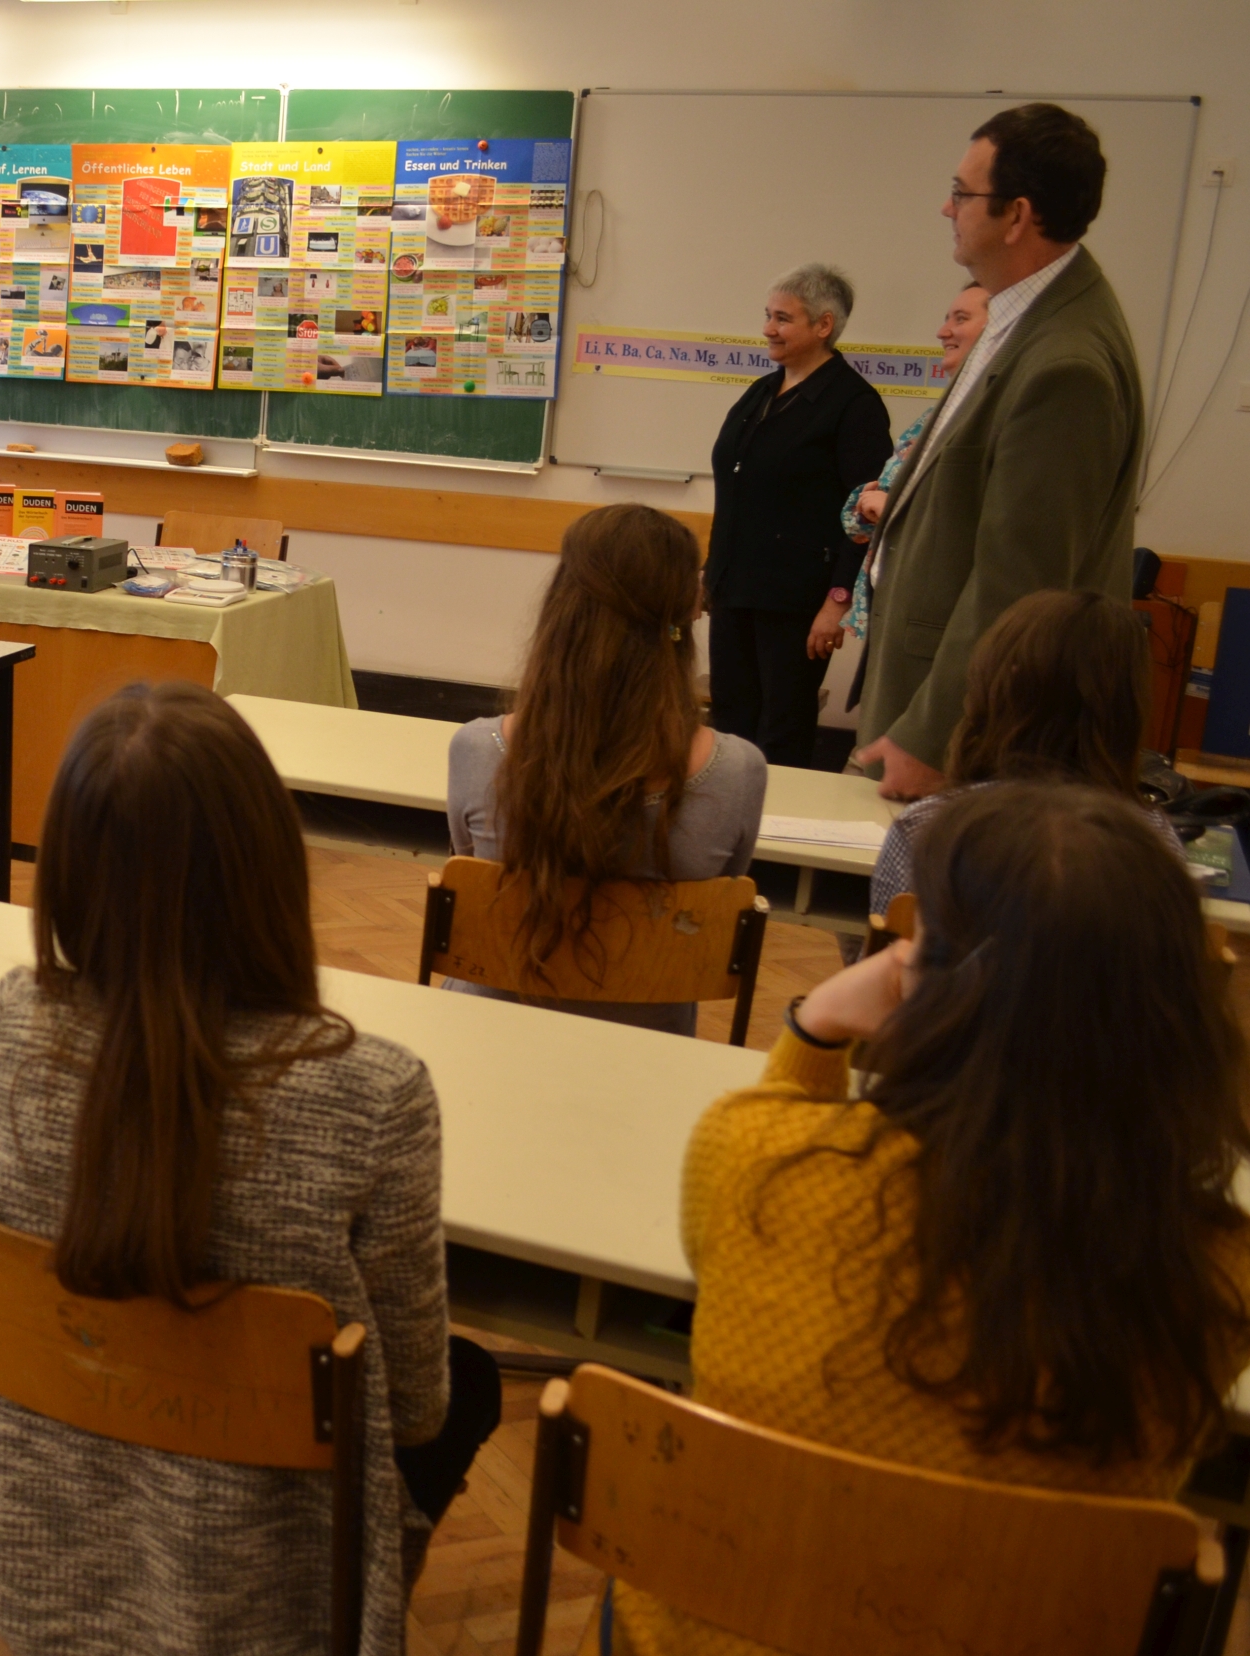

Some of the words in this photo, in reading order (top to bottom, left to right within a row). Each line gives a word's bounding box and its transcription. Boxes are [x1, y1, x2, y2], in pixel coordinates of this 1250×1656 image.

[12, 164, 48, 175] Lernen
[81, 161, 155, 175] Öffentliches
[158, 164, 192, 176] Leben
[239, 161, 274, 173] Stadt
[278, 160, 299, 173] und
[303, 161, 332, 173] Land
[404, 160, 436, 171] Essen
[439, 159, 460, 171] und
[463, 159, 508, 171] Trinken
[298, 327, 319, 339] STOP
[584, 340, 601, 355] Li,
[605, 342, 618, 357] K,
[622, 343, 642, 360] Ba,
[645, 345, 666, 362] Ca,
[669, 347, 691, 363] Na,
[694, 349, 719, 367] Mg,
[725, 351, 744, 367] Al,
[747, 353, 774, 370] Mn,
[853, 360, 873, 375] Ni,
[876, 361, 899, 377] Sn,
[902, 362, 923, 377] Pb
[890, 388, 928, 396] IONILOR
[23, 498, 52, 507] DUDEN
[66, 503, 97, 513] DUDEN
